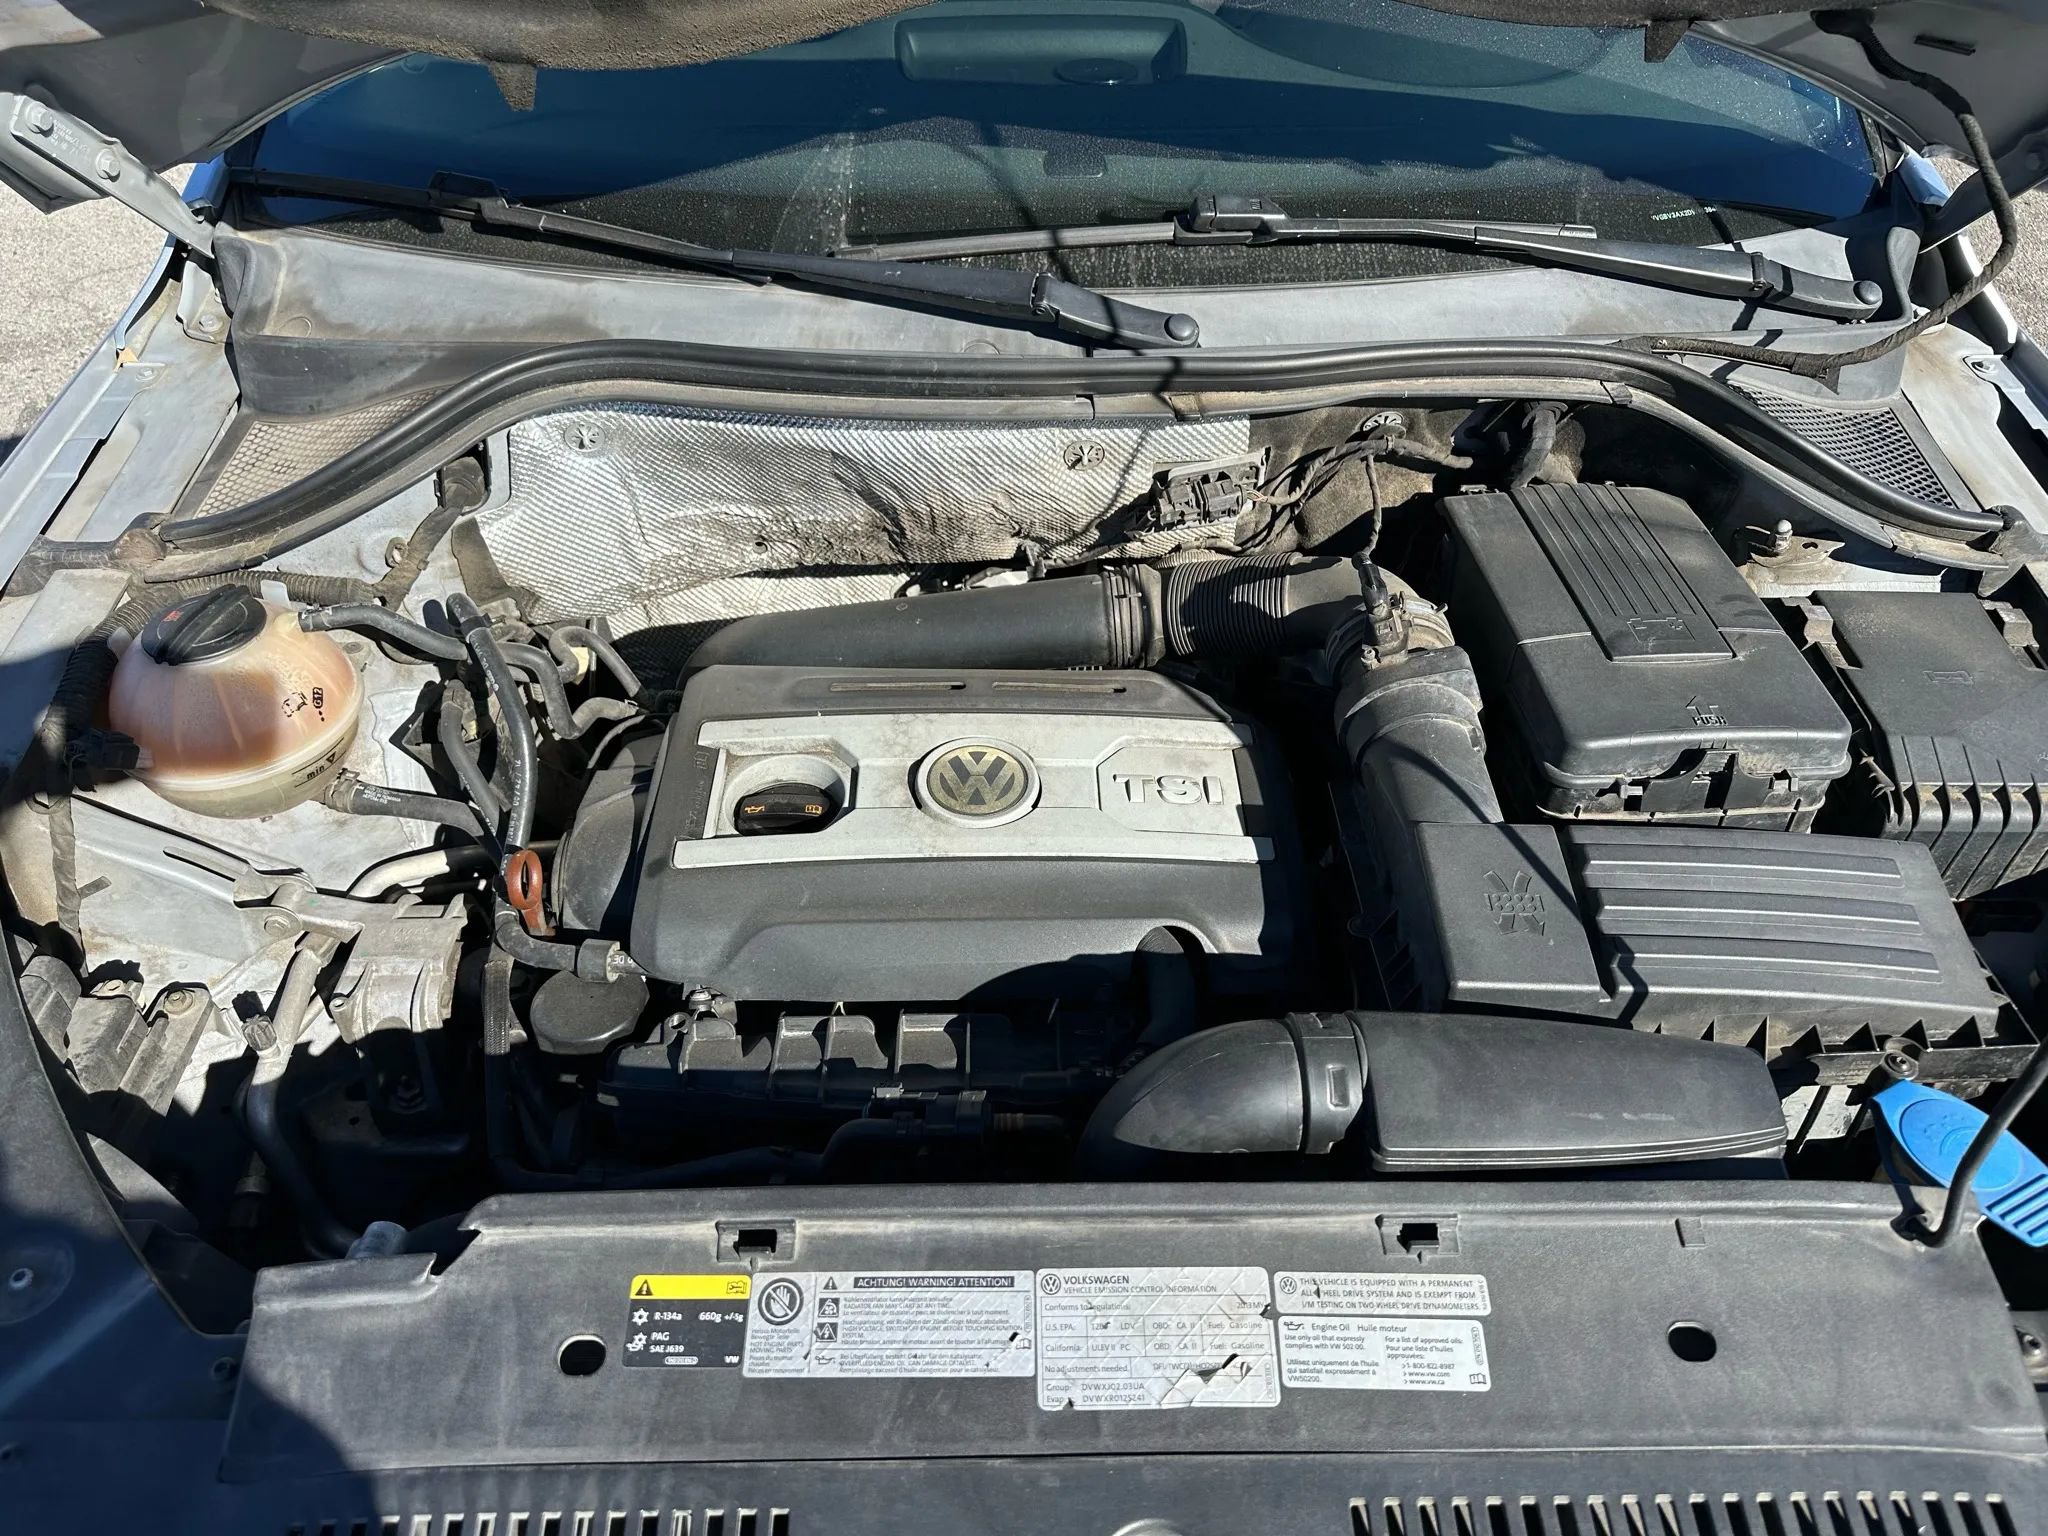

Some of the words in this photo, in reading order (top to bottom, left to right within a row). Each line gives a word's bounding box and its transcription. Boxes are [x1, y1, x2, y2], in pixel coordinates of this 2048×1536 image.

[313, 687, 323, 708] G12
[1692, 715, 1728, 727] PUSH
[306, 765, 325, 779] min
[1113, 774, 1224, 805] TSI
[858, 1278, 905, 1287] ACHTUNG!
[908, 1278, 955, 1287] WARNING!
[958, 1278, 1011, 1287] ATTENTION!
[1063, 1275, 1130, 1285] VOLKSWAGEN
[1360, 1279, 1396, 1287] EQUIPPED
[654, 1311, 683, 1321] R-134a
[698, 1312, 722, 1323] 660g
[1229, 1321, 1263, 1329] Gasoline
[1312, 1323, 1338, 1332] Engine
[1339, 1323, 1350, 1331] Oil
[1357, 1324, 1378, 1332] Huile
[650, 1332, 670, 1341] PAG
[1297, 1334, 1311, 1342] only
[1336, 1335, 1365, 1343] expressly
[649, 1344, 664, 1353] SAE
[665, 1344, 685, 1353] J639
[1231, 1342, 1265, 1350] Gasoline
